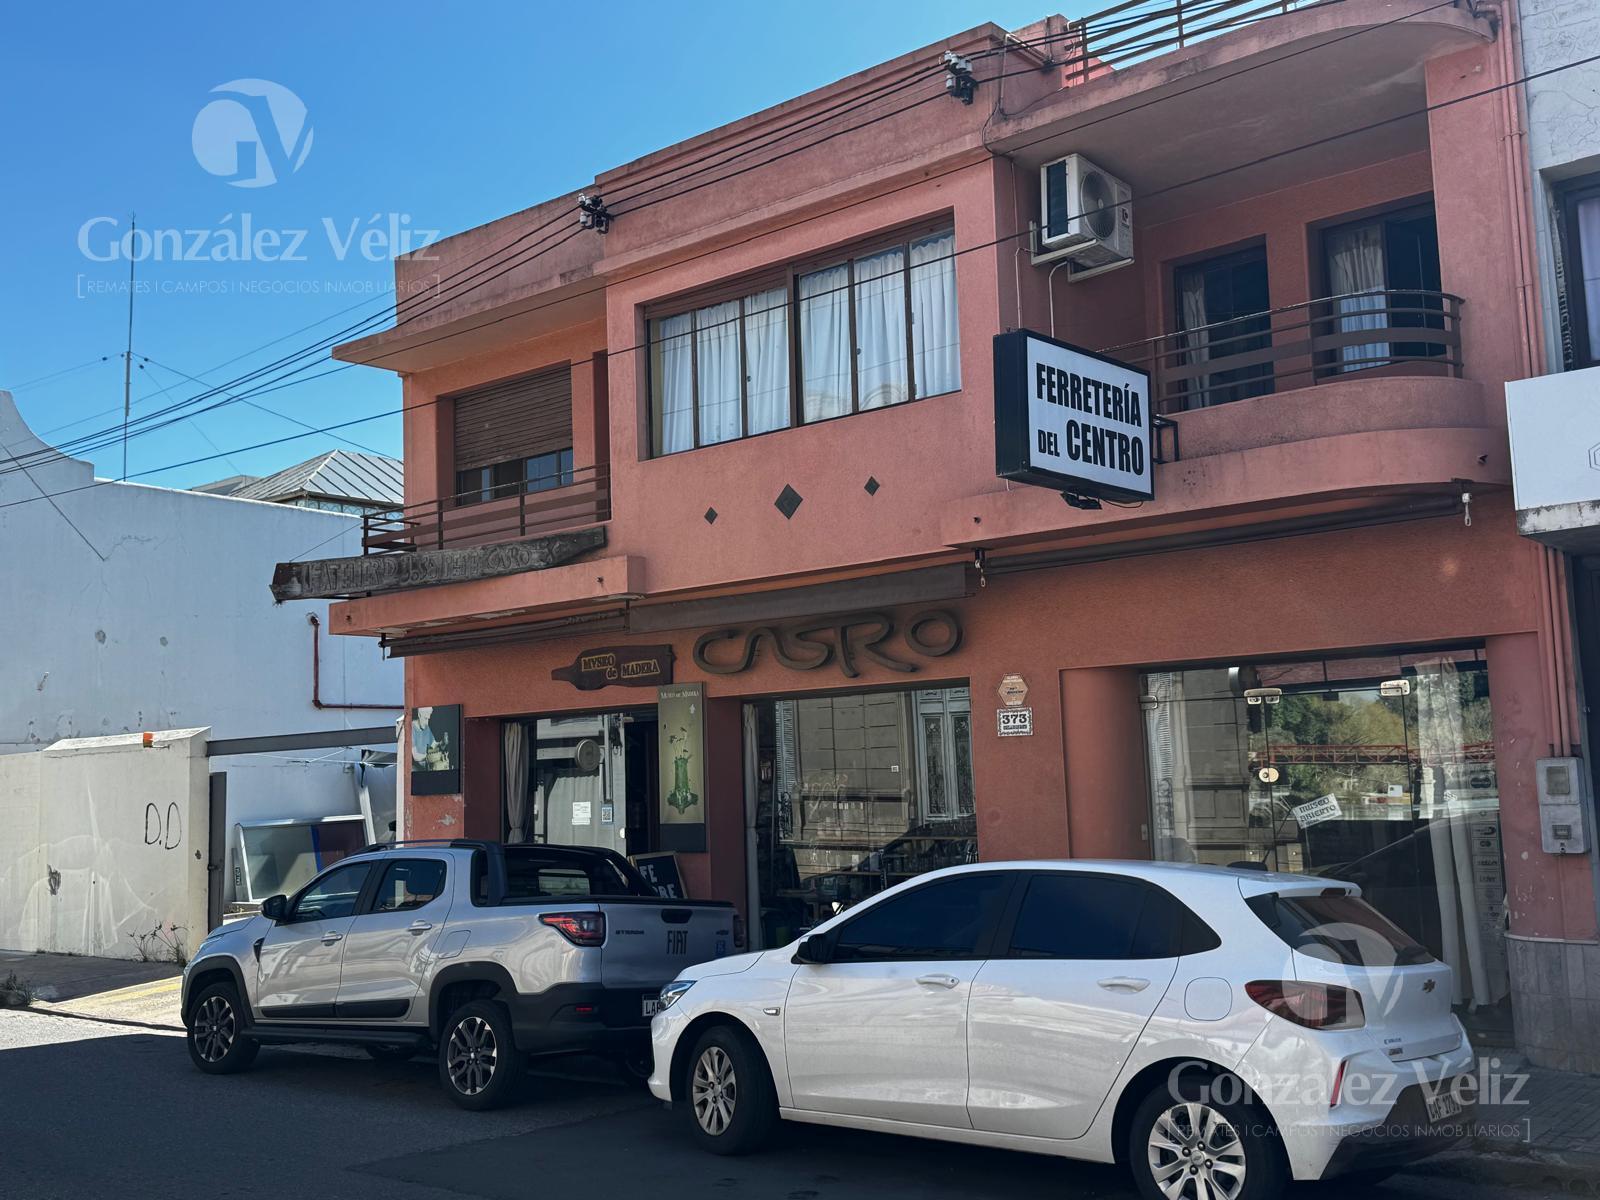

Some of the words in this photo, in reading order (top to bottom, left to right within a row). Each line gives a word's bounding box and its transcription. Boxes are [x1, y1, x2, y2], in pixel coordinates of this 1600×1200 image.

[1036, 362, 1142, 427] FERRETERÍA
[1037, 429, 1060, 457] DEL
[1066, 419, 1144, 476] CENTRO
[606, 667, 618, 680] de
[1002, 713, 1027, 724] 373
[666, 930, 688, 954] FIAT
